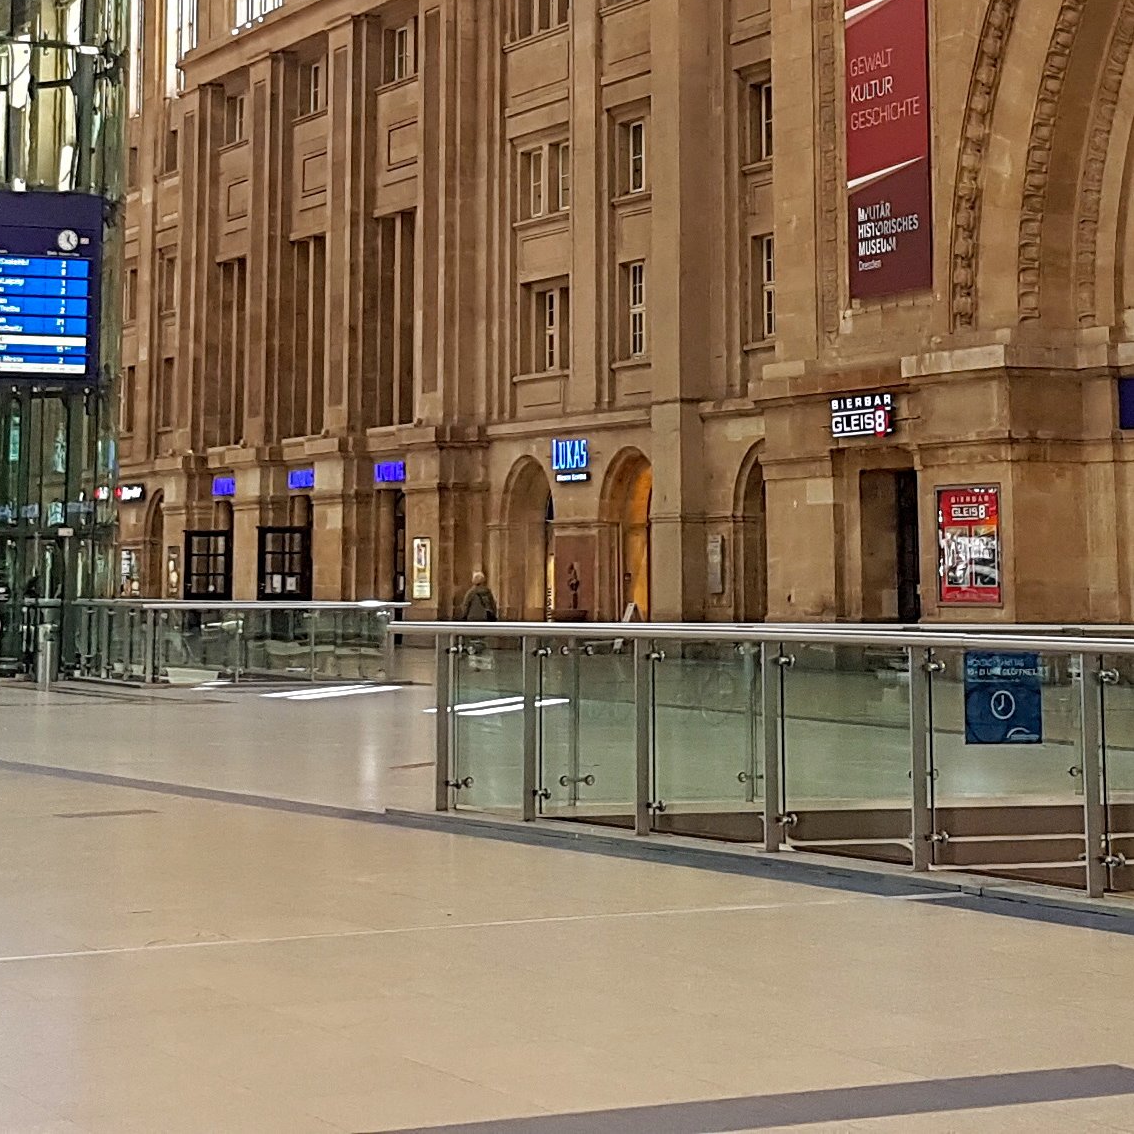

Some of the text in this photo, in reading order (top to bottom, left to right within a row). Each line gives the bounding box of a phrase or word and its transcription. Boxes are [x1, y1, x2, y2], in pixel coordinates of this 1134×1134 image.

[850, 48, 893, 76] GEWALT
[850, 76, 893, 104] KULTUR
[851, 96, 920, 130] GESCHICHTE
[858, 201, 890, 222] MILITÄR
[858, 214, 918, 239] HISTORISCHES
[859, 236, 896, 256] MUSEUM
[832, 394, 891, 410] BIERBAR
[552, 439, 587, 470] LUKAS
